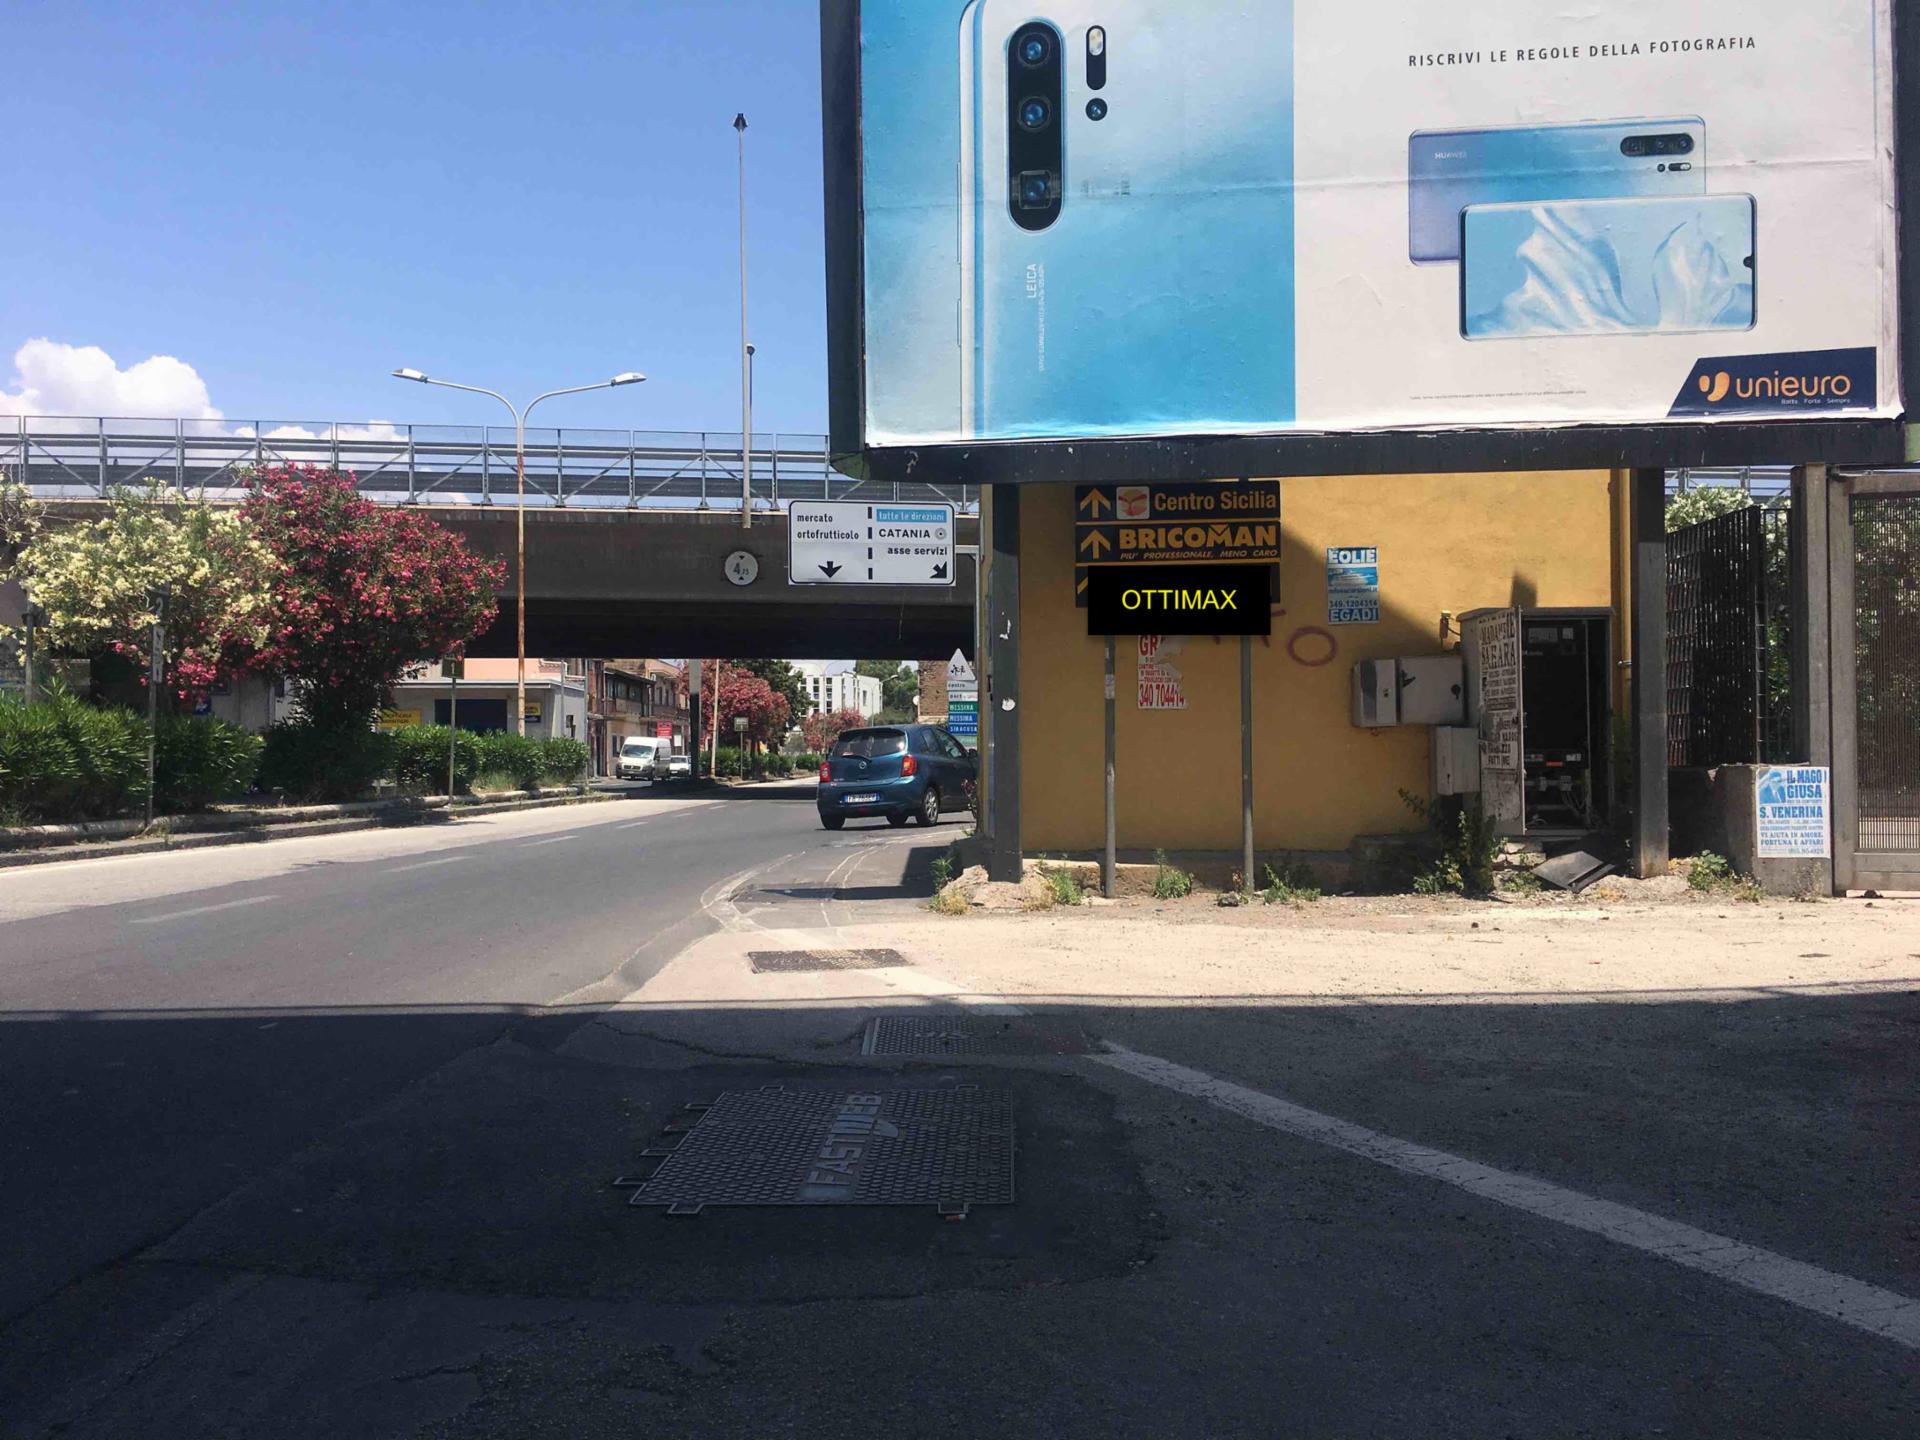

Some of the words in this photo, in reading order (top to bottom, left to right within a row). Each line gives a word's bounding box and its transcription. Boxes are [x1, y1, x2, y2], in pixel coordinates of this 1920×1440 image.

[1408, 51, 1481, 67] RISCRIVI
[1490, 50, 1508, 63] LE
[1516, 46, 1580, 61] REGOLE
[1589, 43, 1641, 57] DELLA
[1649, 37, 1756, 54] FOTOGRAFIA
[1026, 263, 1037, 299] LEICA
[1736, 370, 1853, 398] unieuro
[1154, 492, 1216, 512] Centro
[1220, 489, 1277, 511] Sicilia
[797, 513, 833, 523] mercato
[879, 511, 900, 522] tutte
[901, 511, 909, 521] le
[911, 511, 945, 521] direzioni
[797, 529, 860, 540] ortofrutticolo
[879, 528, 931, 539] CATANIA
[1119, 524, 1277, 550] BRICOMAN
[887, 547, 911, 556] asse
[914, 546, 948, 556] servizi
[1220, 549, 1248, 558] MENO
[1253, 549, 1278, 558] CARO
[1328, 550, 1376, 564] EOLIE
[1330, 608, 1377, 622] EGADI
[1797, 769, 1822, 784] MAGO
[1787, 784, 1822, 799] GIUSA
[1760, 806, 1770, 819] S.
[1772, 805, 1823, 819] VENERINA
[807, 1093, 882, 1187] FASTWEB
